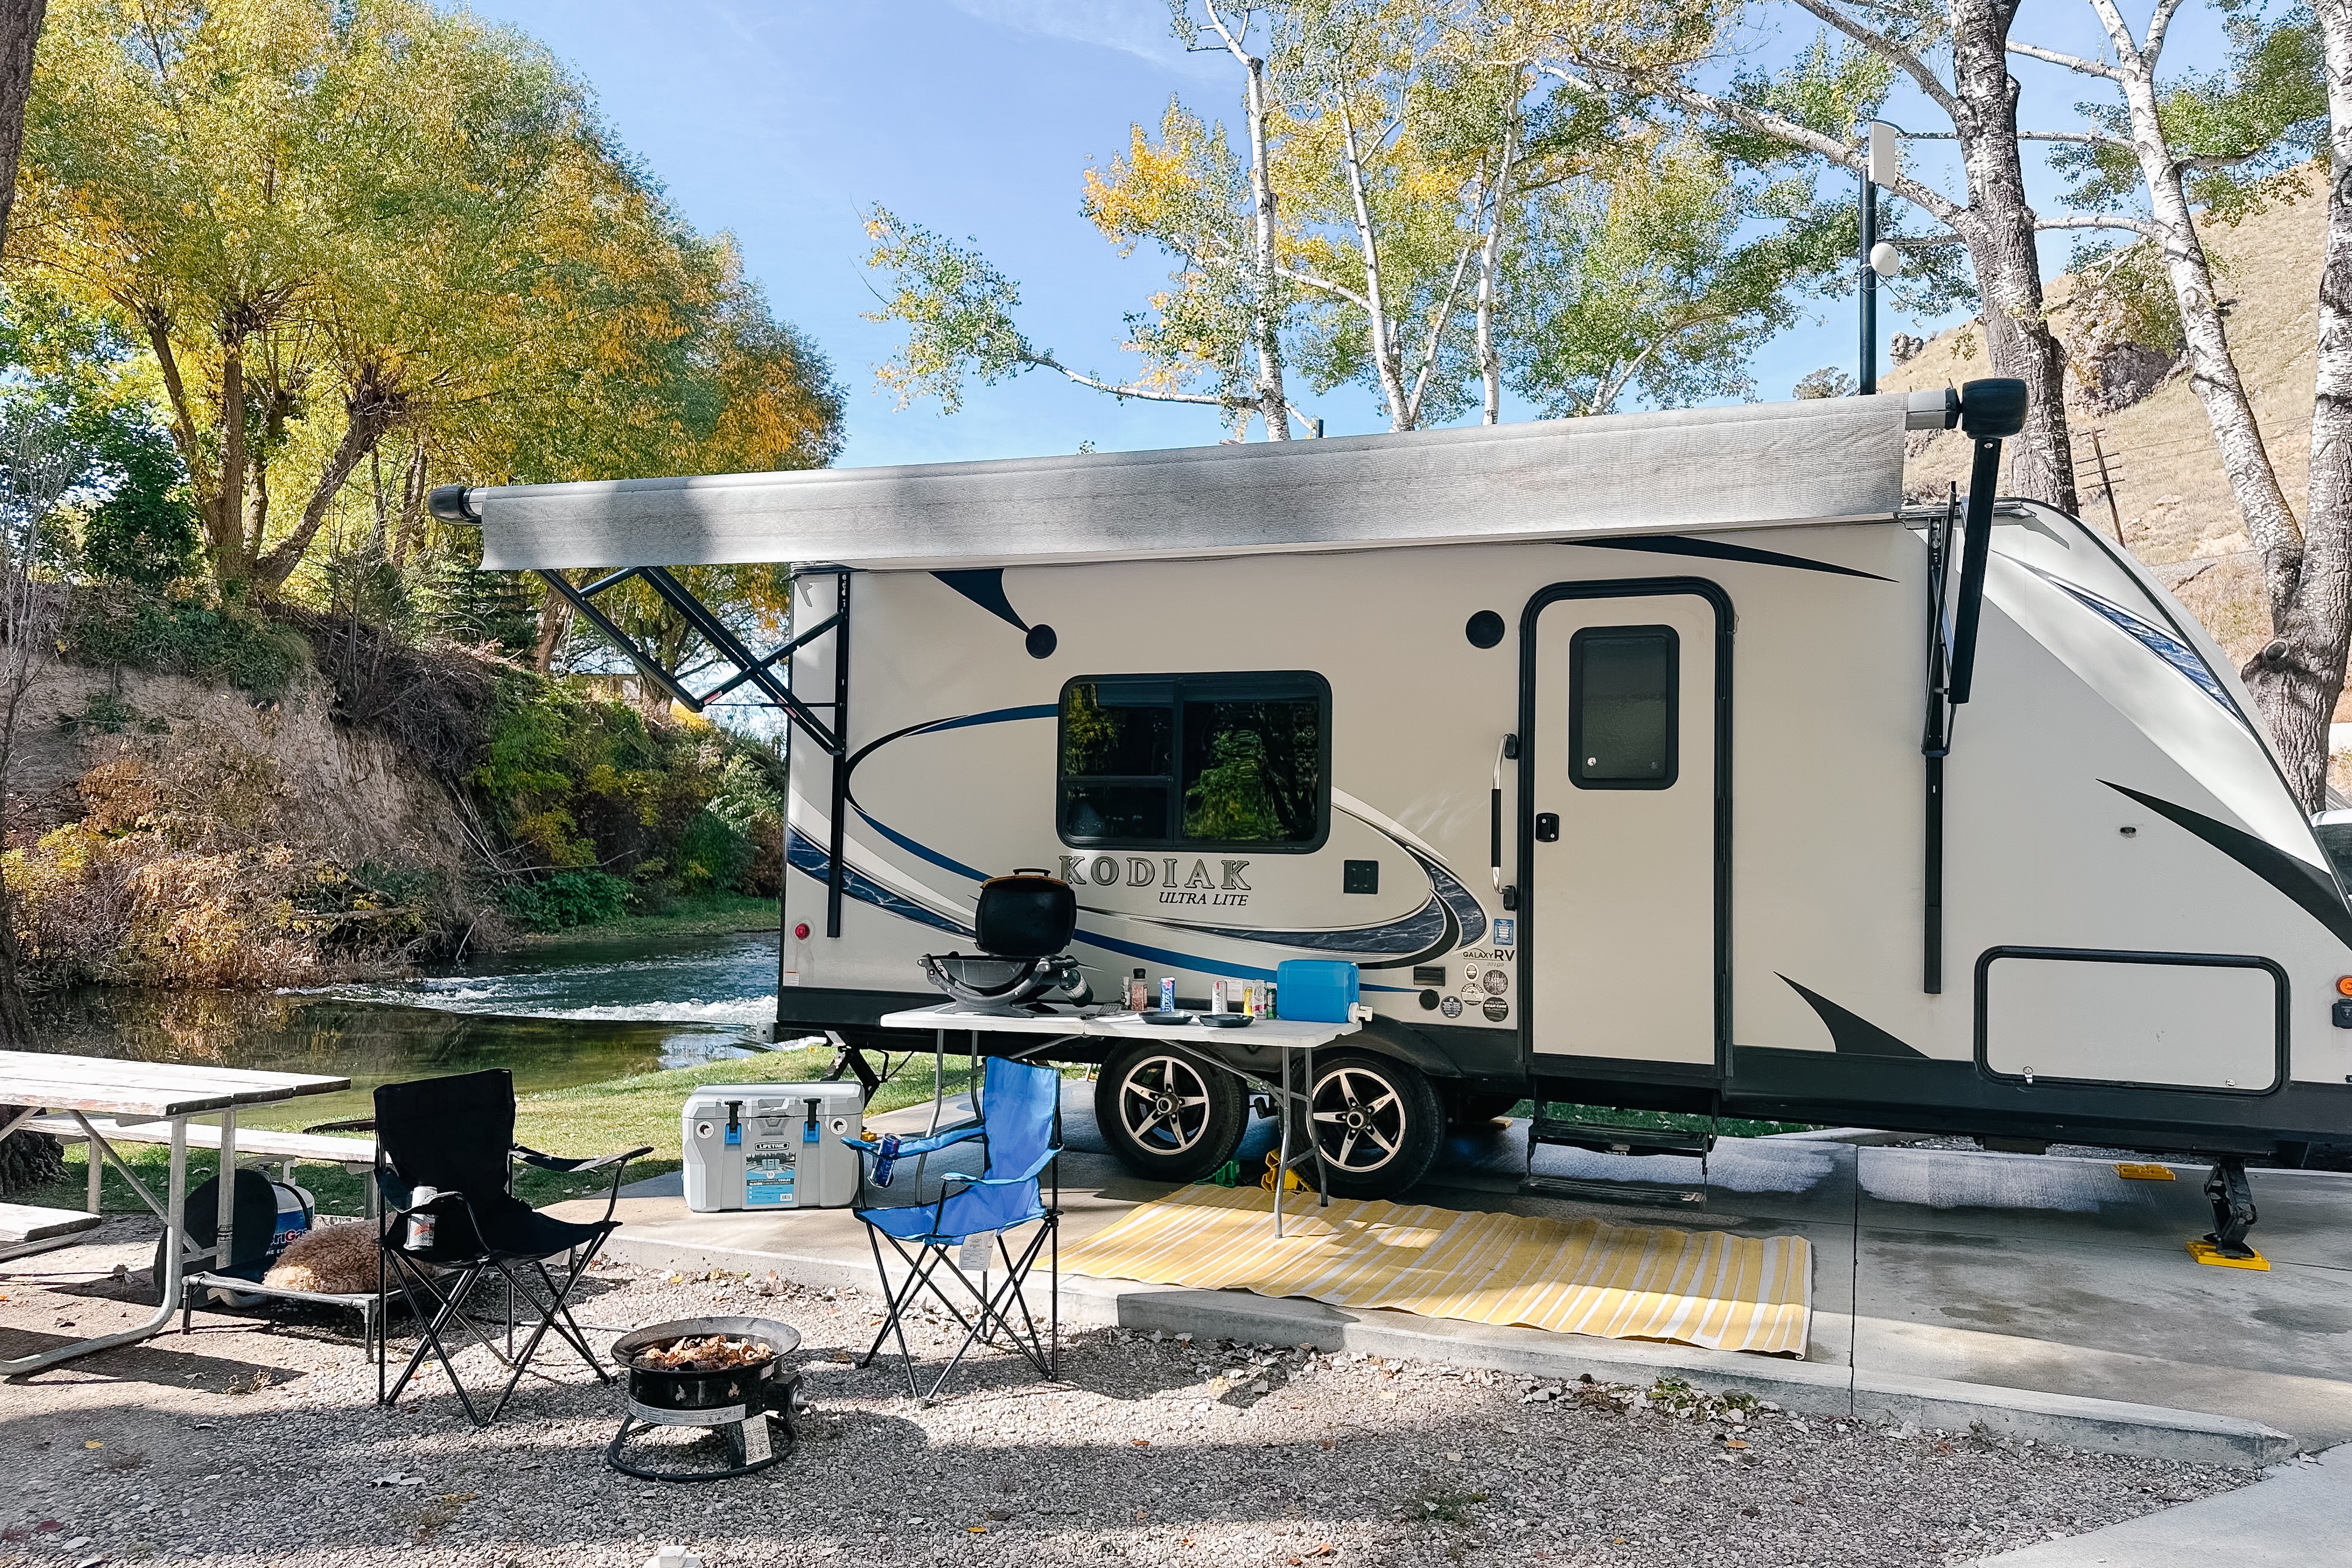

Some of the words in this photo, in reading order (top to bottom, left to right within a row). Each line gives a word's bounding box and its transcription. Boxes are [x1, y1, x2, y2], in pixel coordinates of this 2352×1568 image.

[1059, 855, 1251, 890] KODIAK
[1158, 891, 1206, 905] ULTRA
[1212, 893, 1249, 906] LITE
[1494, 949, 1516, 961] RV
